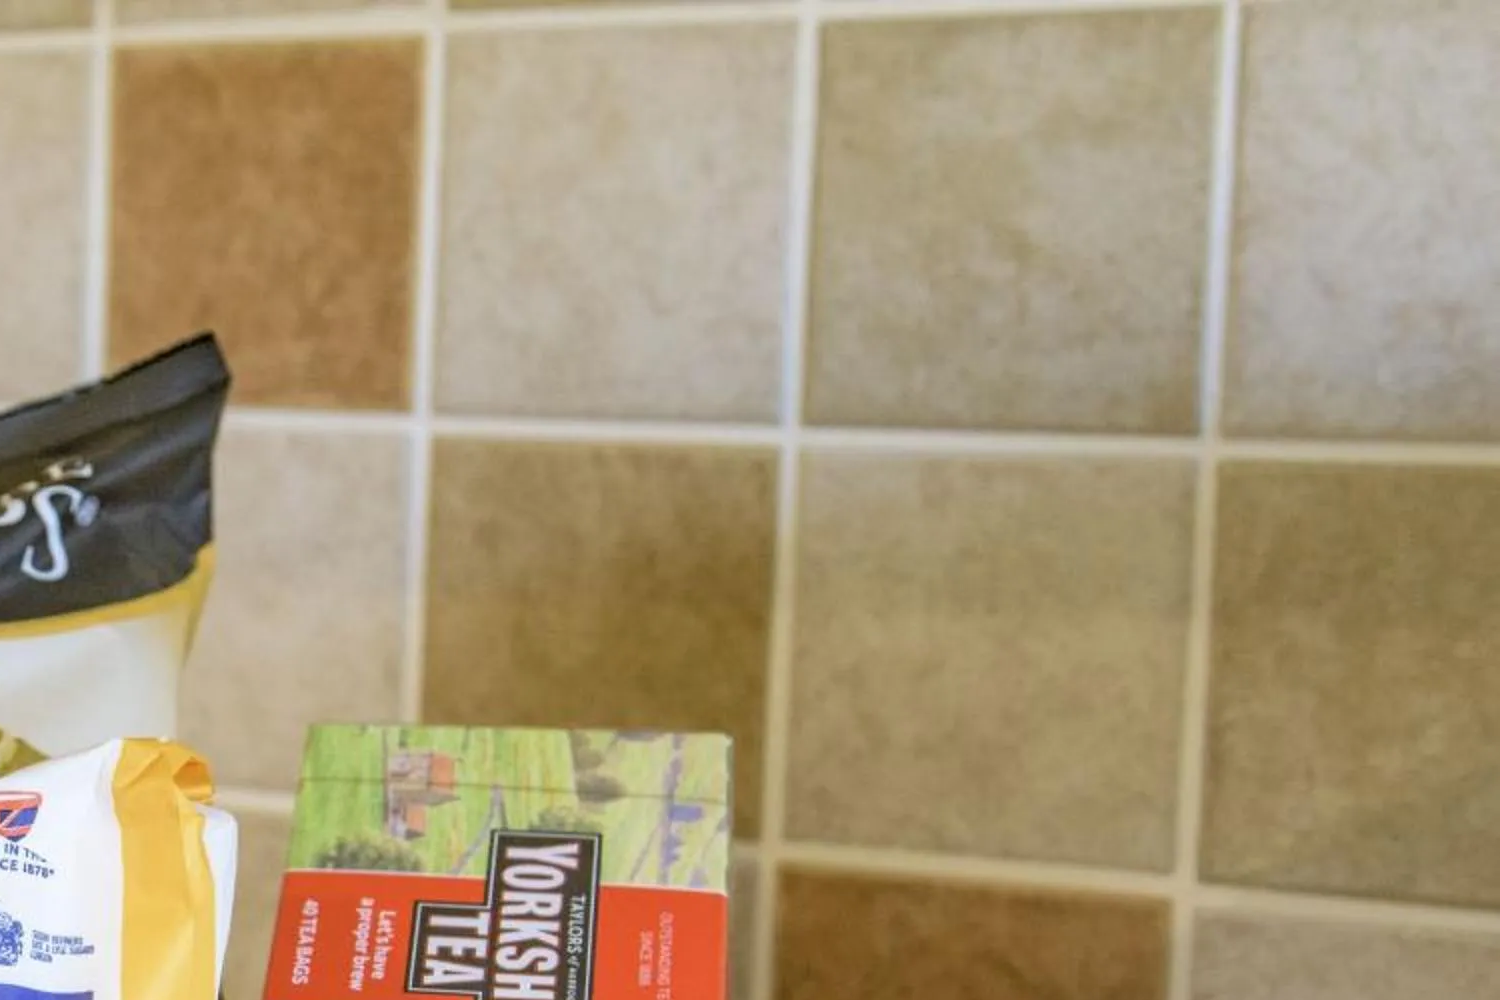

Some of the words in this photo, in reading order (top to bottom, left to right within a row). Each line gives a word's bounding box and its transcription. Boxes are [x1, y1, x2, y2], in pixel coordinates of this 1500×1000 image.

[4, 843, 19, 856] IN
[361, 897, 375, 906] a
[298, 917, 318, 944] TEA
[351, 907, 372, 953] proper
[376, 910, 396, 944] Let's
[566, 894, 586, 953] TAYLORS
[291, 945, 314, 984] BAGS
[371, 945, 393, 980] have
[423, 911, 490, 986] TEA
[348, 955, 370, 991] brew
